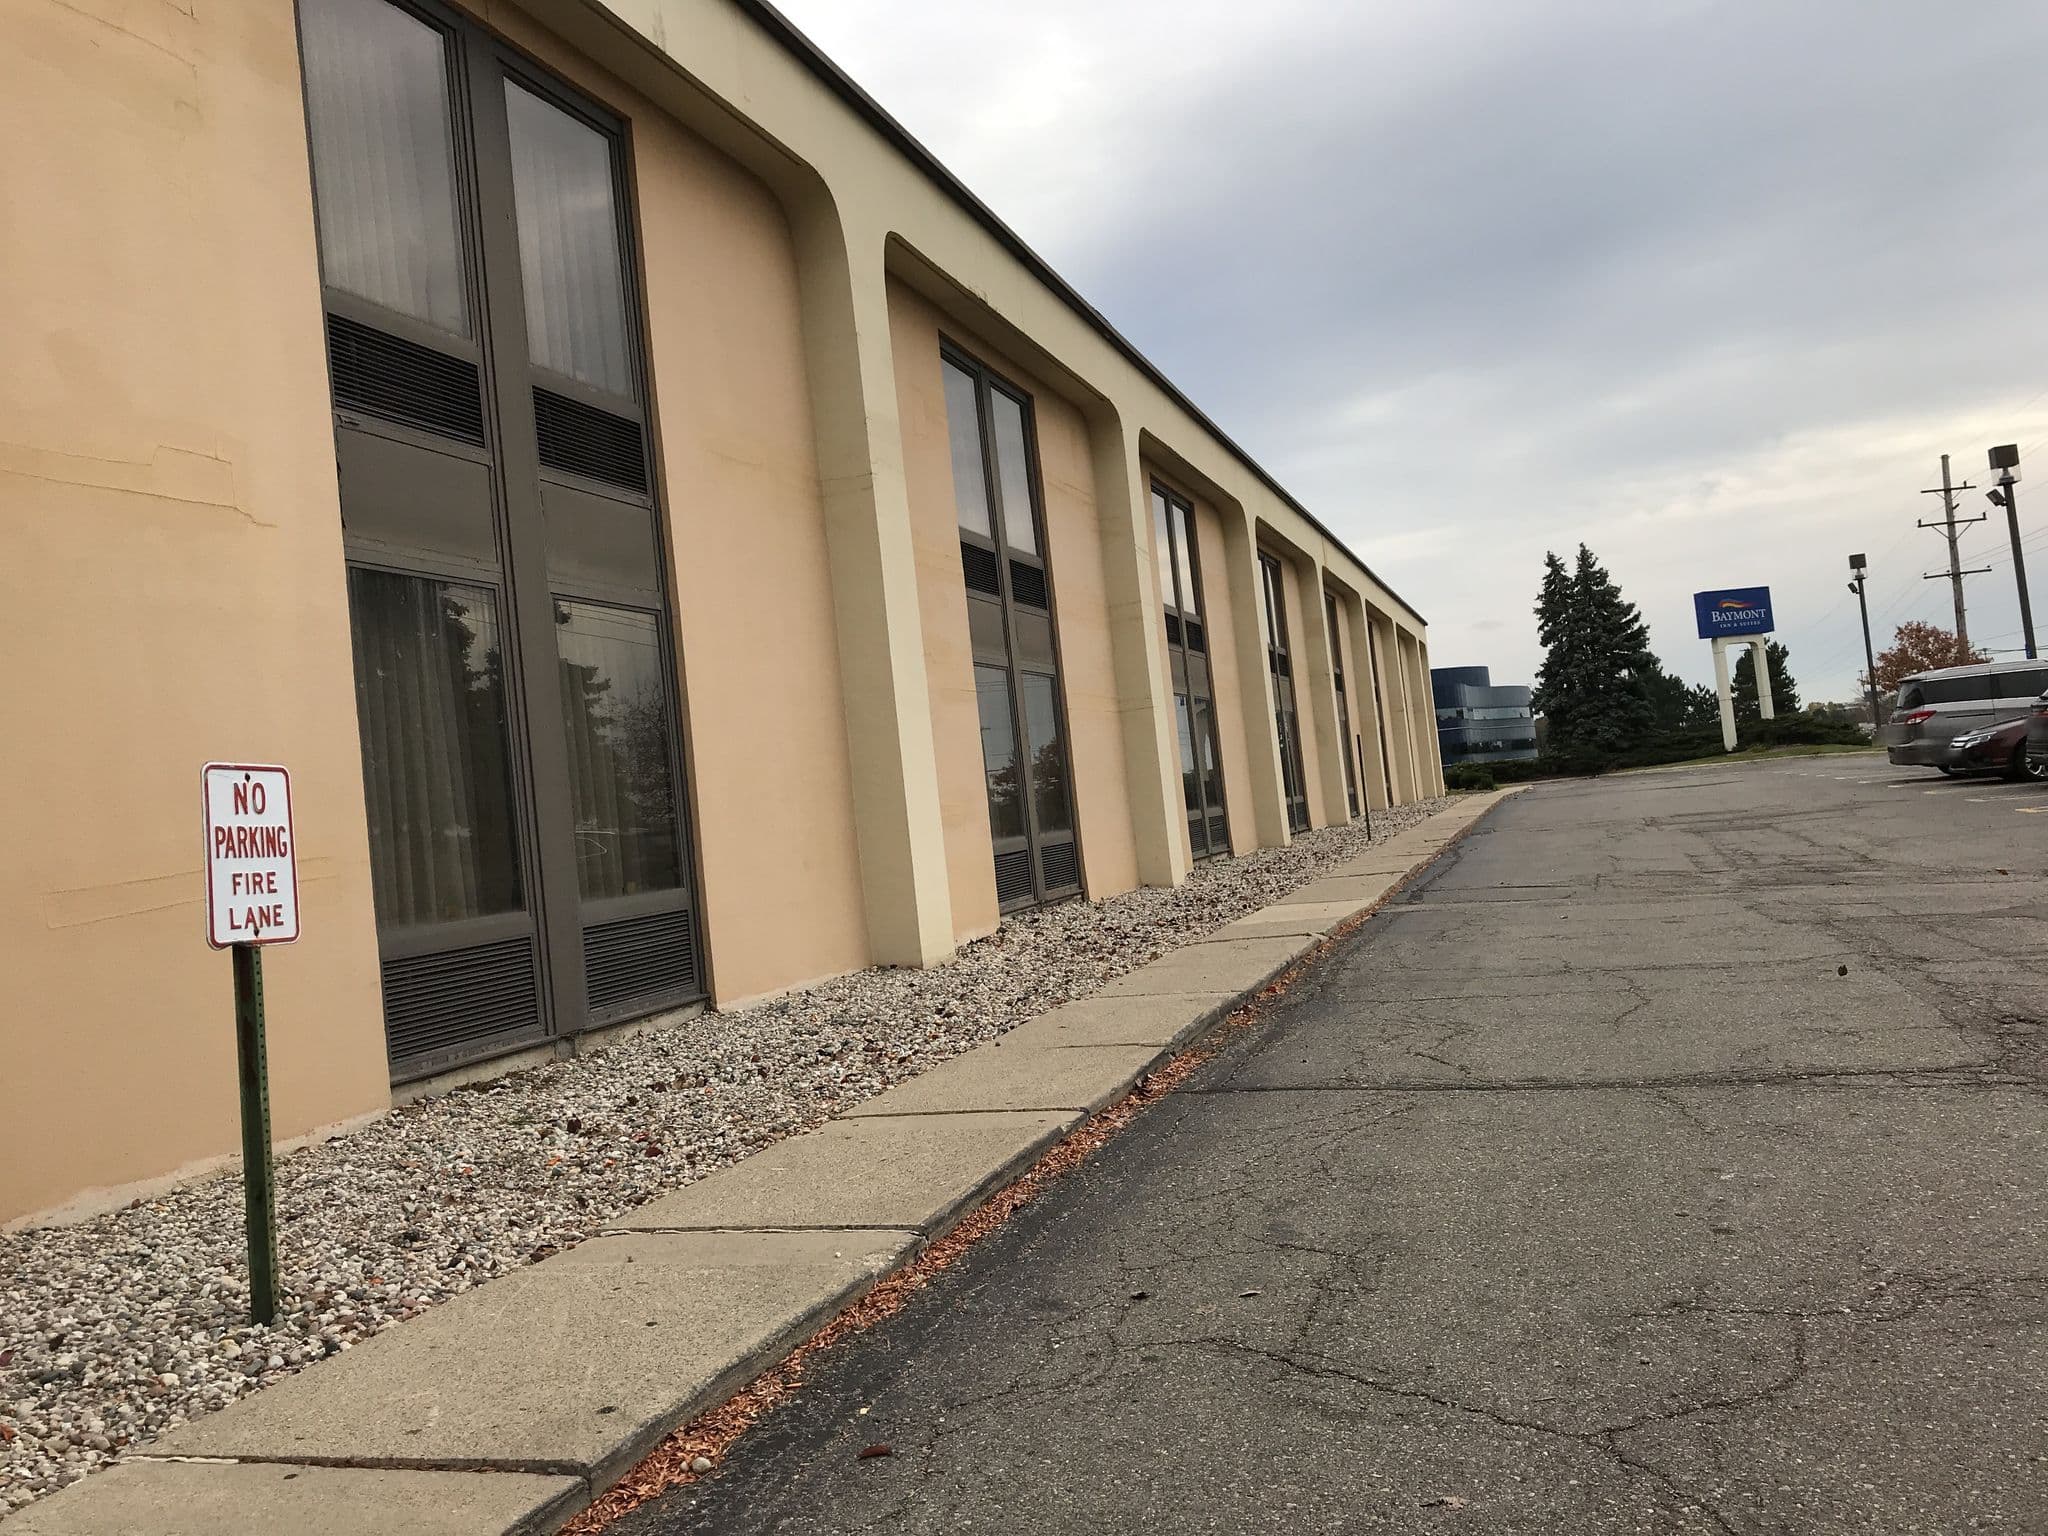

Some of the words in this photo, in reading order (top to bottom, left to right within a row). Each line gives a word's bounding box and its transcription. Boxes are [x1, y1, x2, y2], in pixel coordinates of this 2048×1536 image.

[1712, 609, 1766, 622] BAYMONT
[233, 782, 266, 815] NO
[214, 825, 288, 859] PARKING
[232, 871, 278, 896] FIRE
[229, 904, 284, 930] LANE
